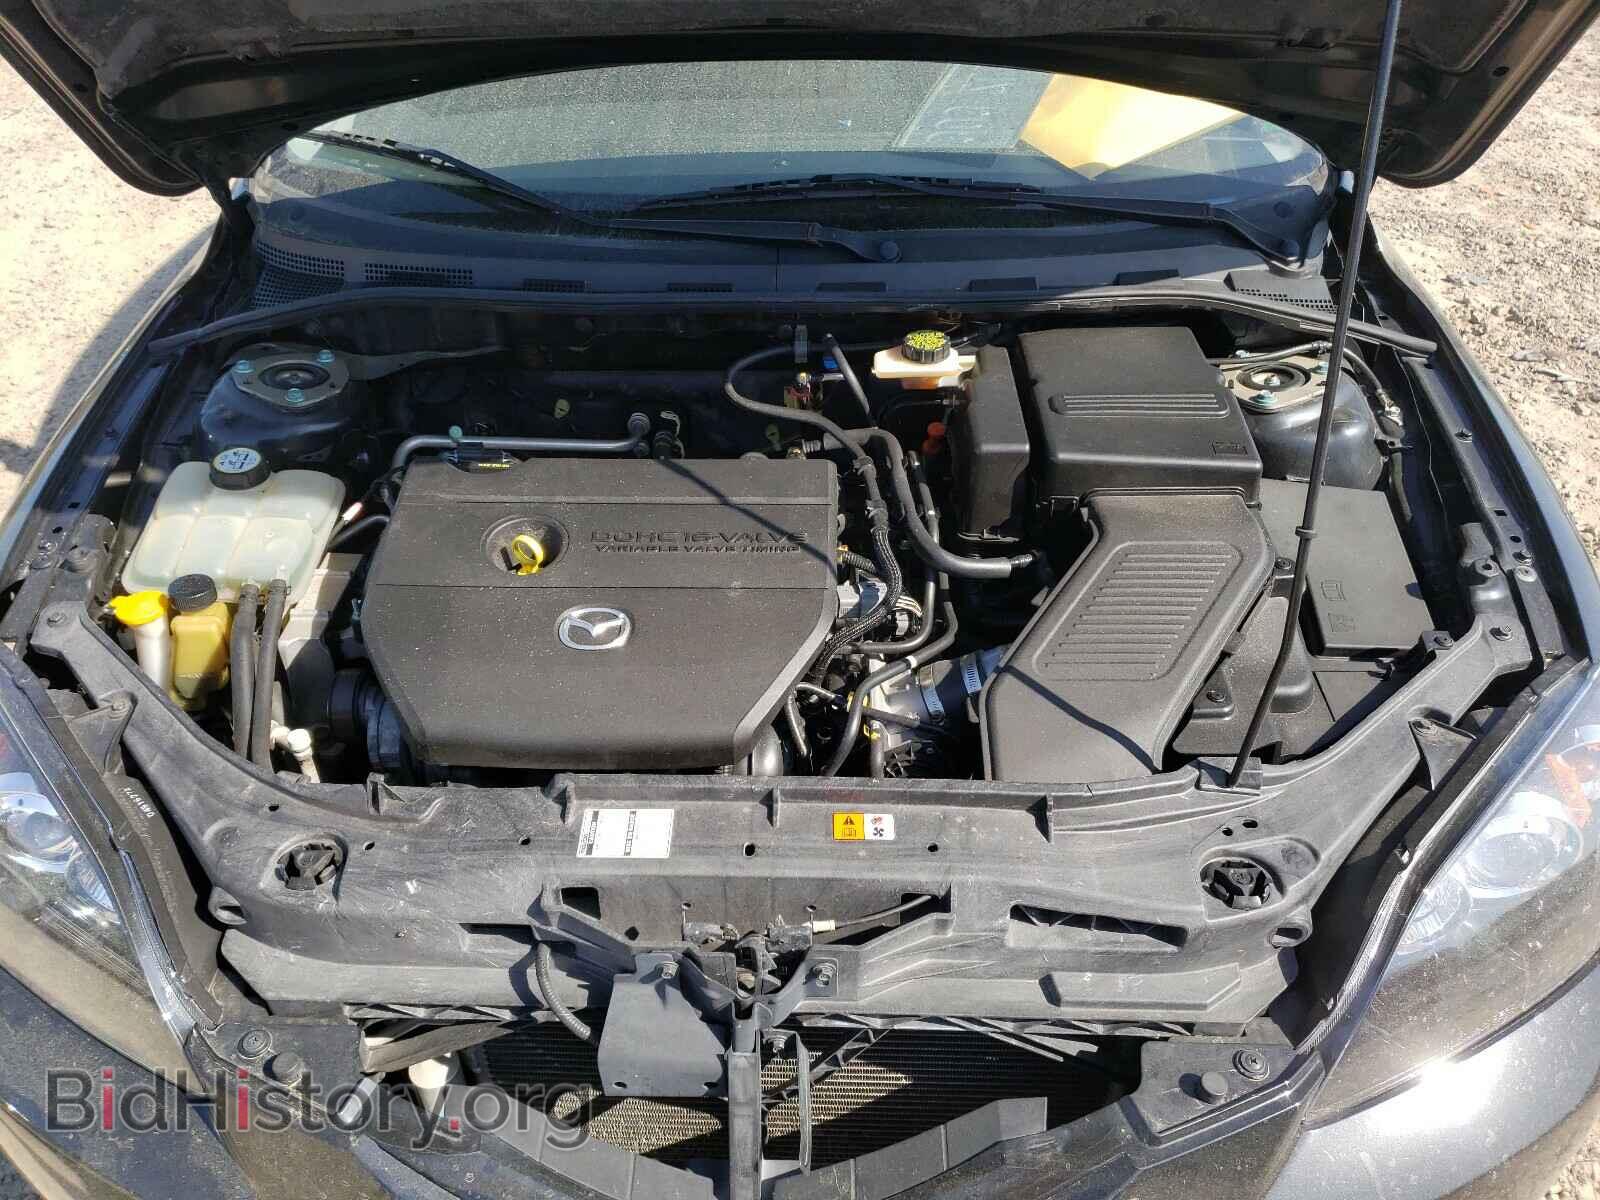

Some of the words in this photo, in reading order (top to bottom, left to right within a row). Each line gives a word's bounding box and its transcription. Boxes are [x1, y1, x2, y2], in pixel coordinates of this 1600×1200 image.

[591, 529, 681, 543] DOHC
[594, 544, 680, 553] VARIABLE
[683, 544, 737, 553] VALVE
[742, 544, 801, 553] TIMING
